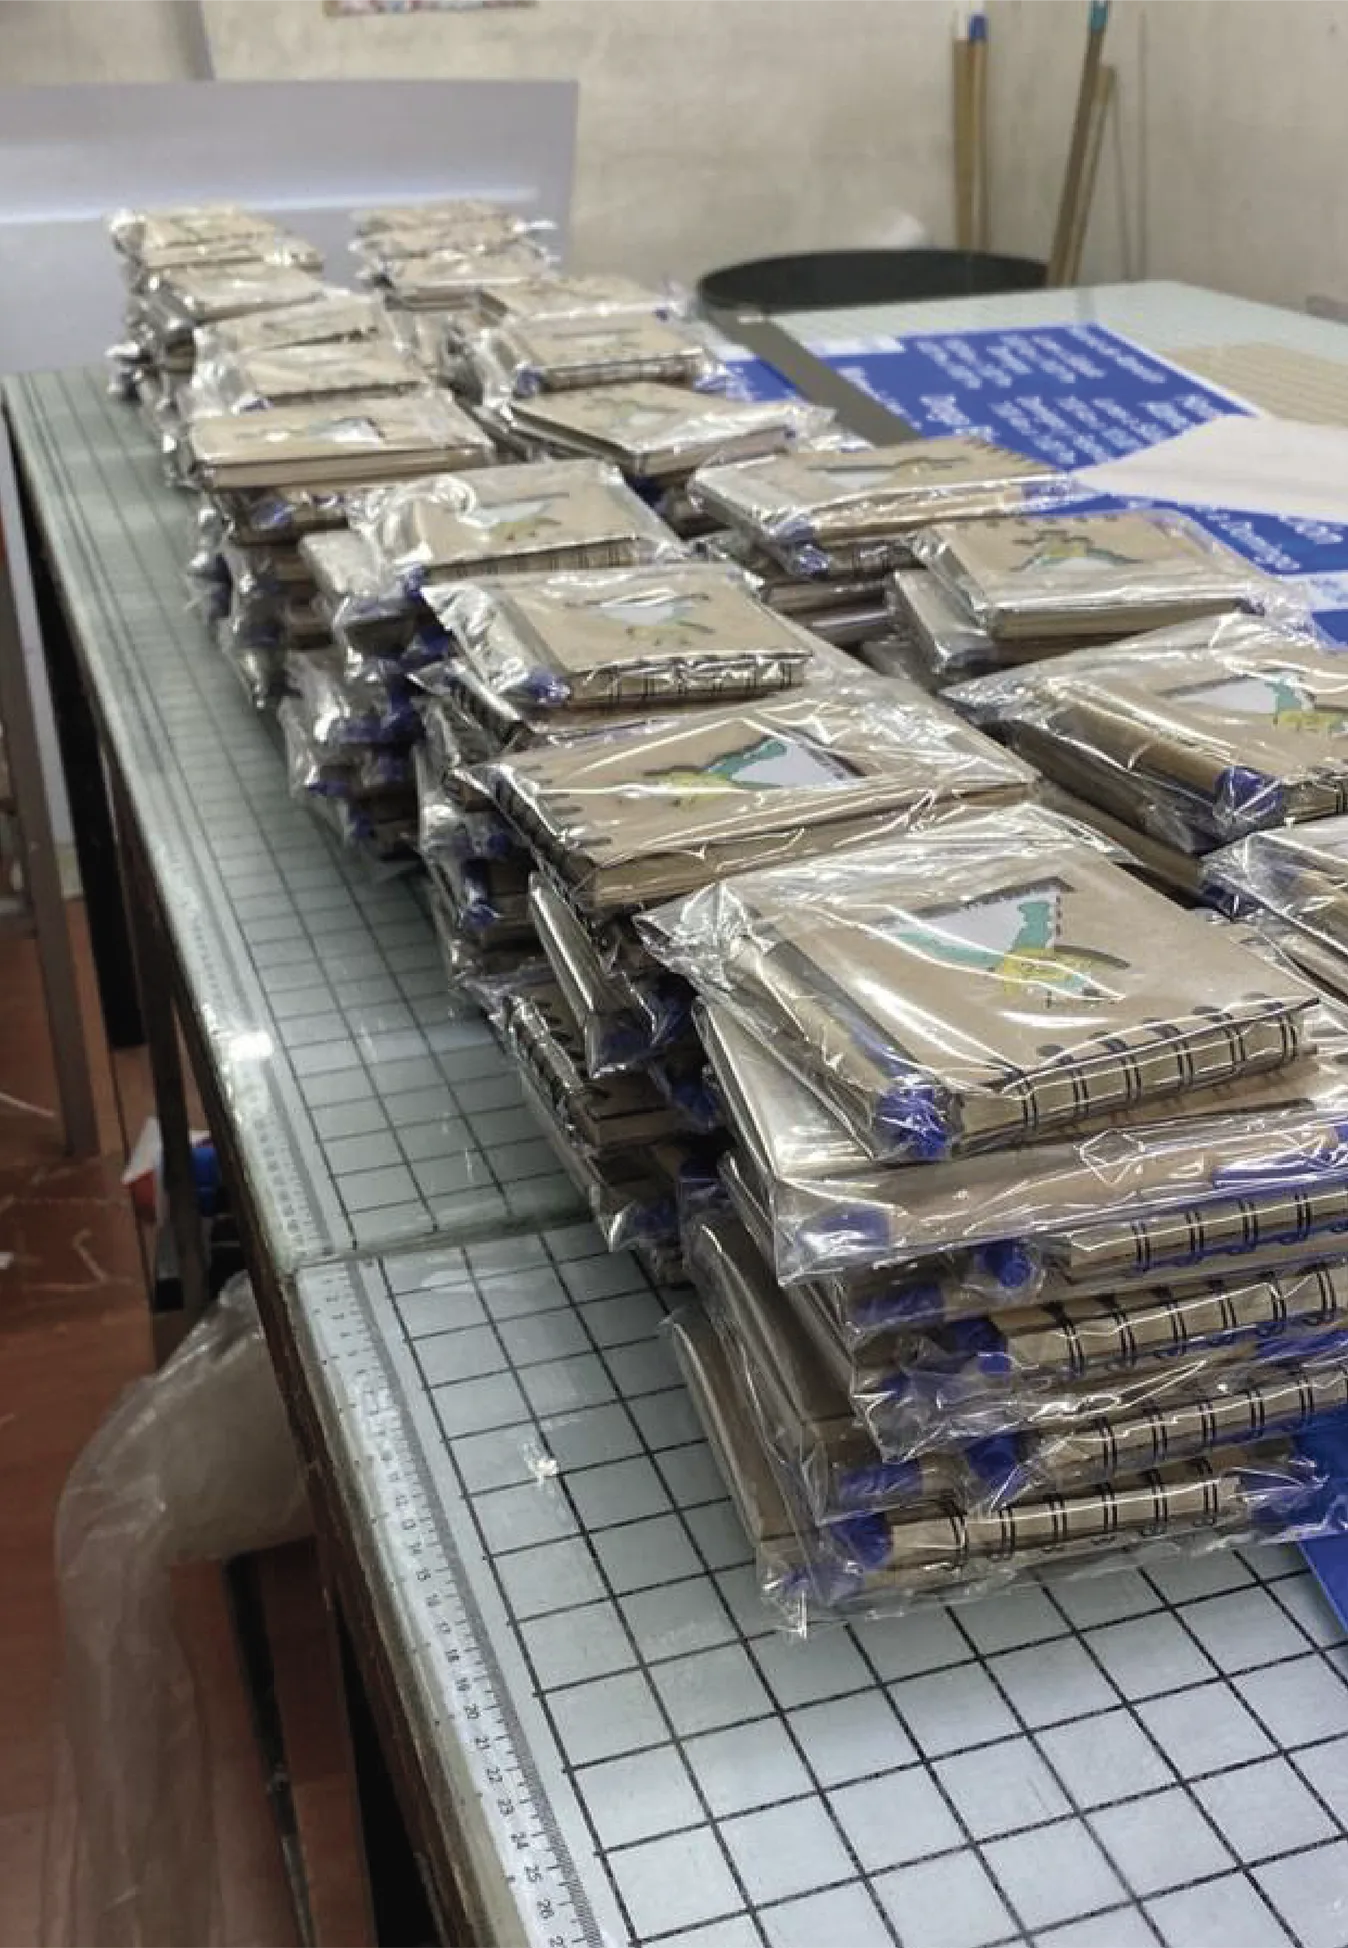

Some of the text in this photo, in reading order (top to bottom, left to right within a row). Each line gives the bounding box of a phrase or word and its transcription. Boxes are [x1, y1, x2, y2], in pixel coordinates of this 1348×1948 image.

[464, 1703, 481, 1720] 20
[487, 1766, 503, 1784] 22
[498, 1797, 515, 1816] 23
[510, 1831, 530, 1850] 24
[524, 1865, 542, 1883] 25
[550, 1935, 566, 1948] 2
